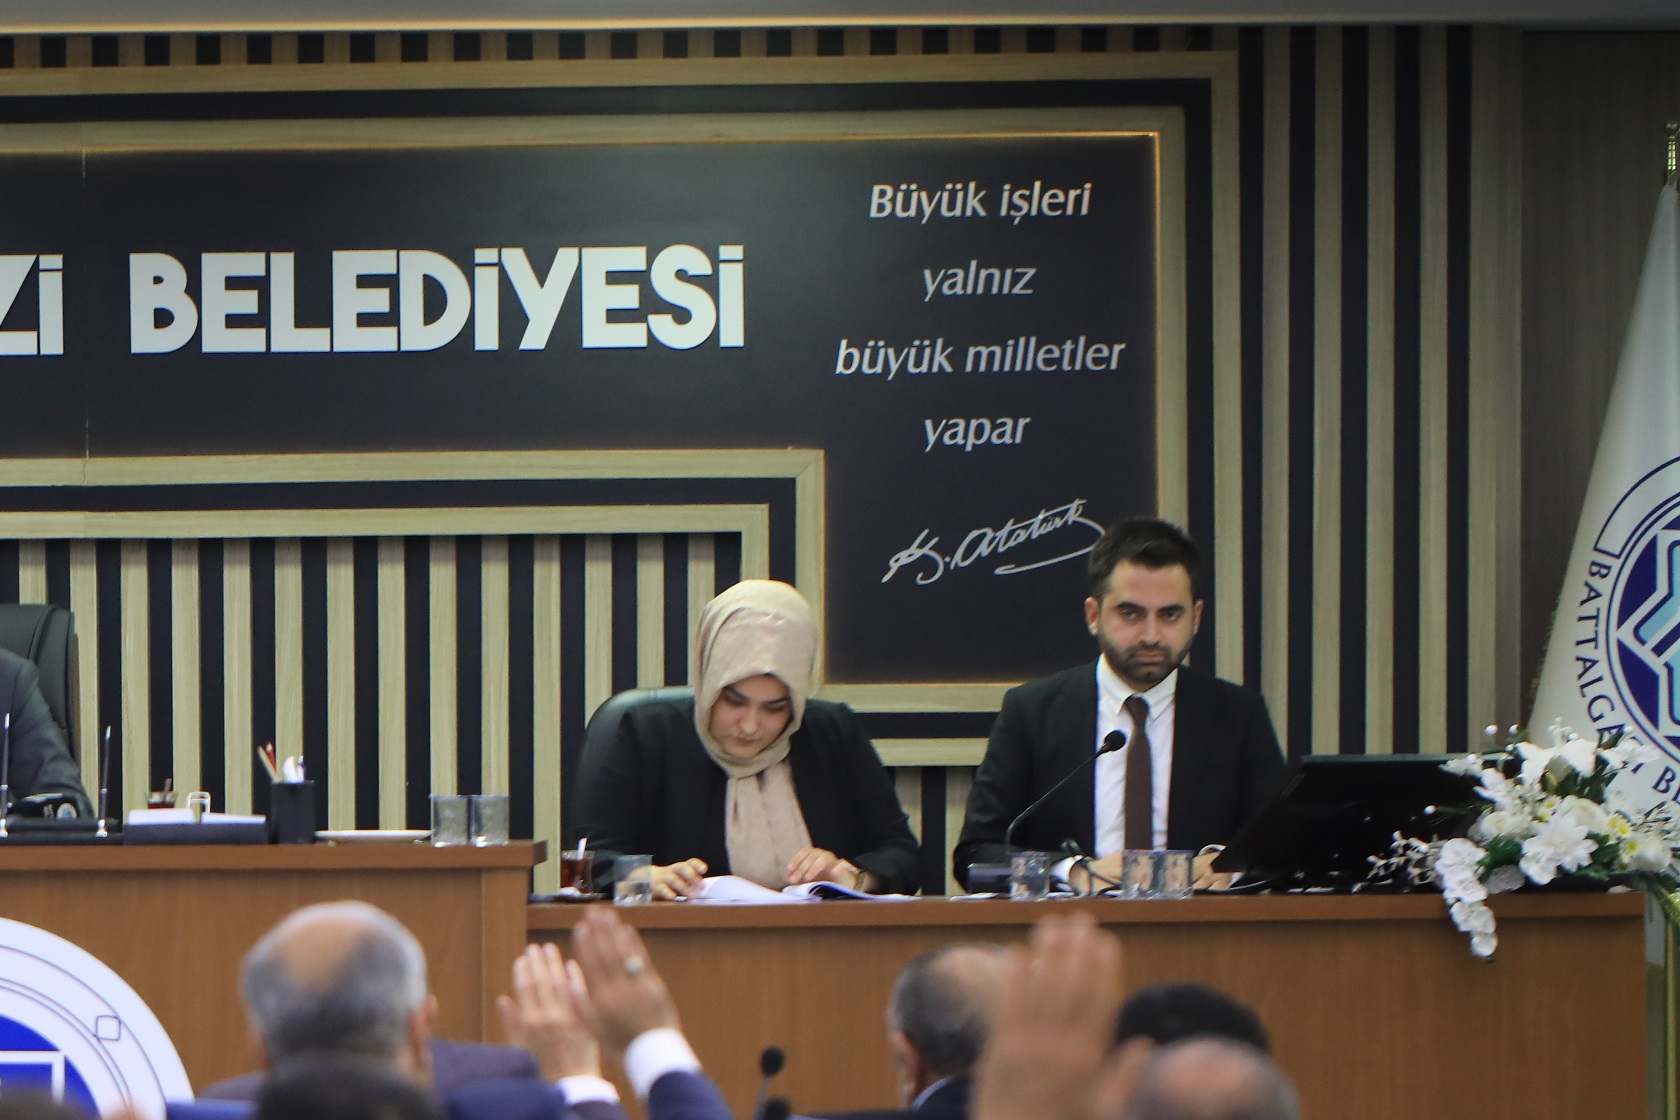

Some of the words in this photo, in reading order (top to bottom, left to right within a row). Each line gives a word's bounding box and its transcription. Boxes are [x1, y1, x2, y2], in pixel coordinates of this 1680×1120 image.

[869, 182, 987, 224] Büyük
[999, 181, 1092, 226] işleri
[923, 260, 1037, 302] yalnız
[835, 338, 954, 380] büyük
[965, 336, 1127, 373] milletler
[924, 418, 1031, 452] yapar
